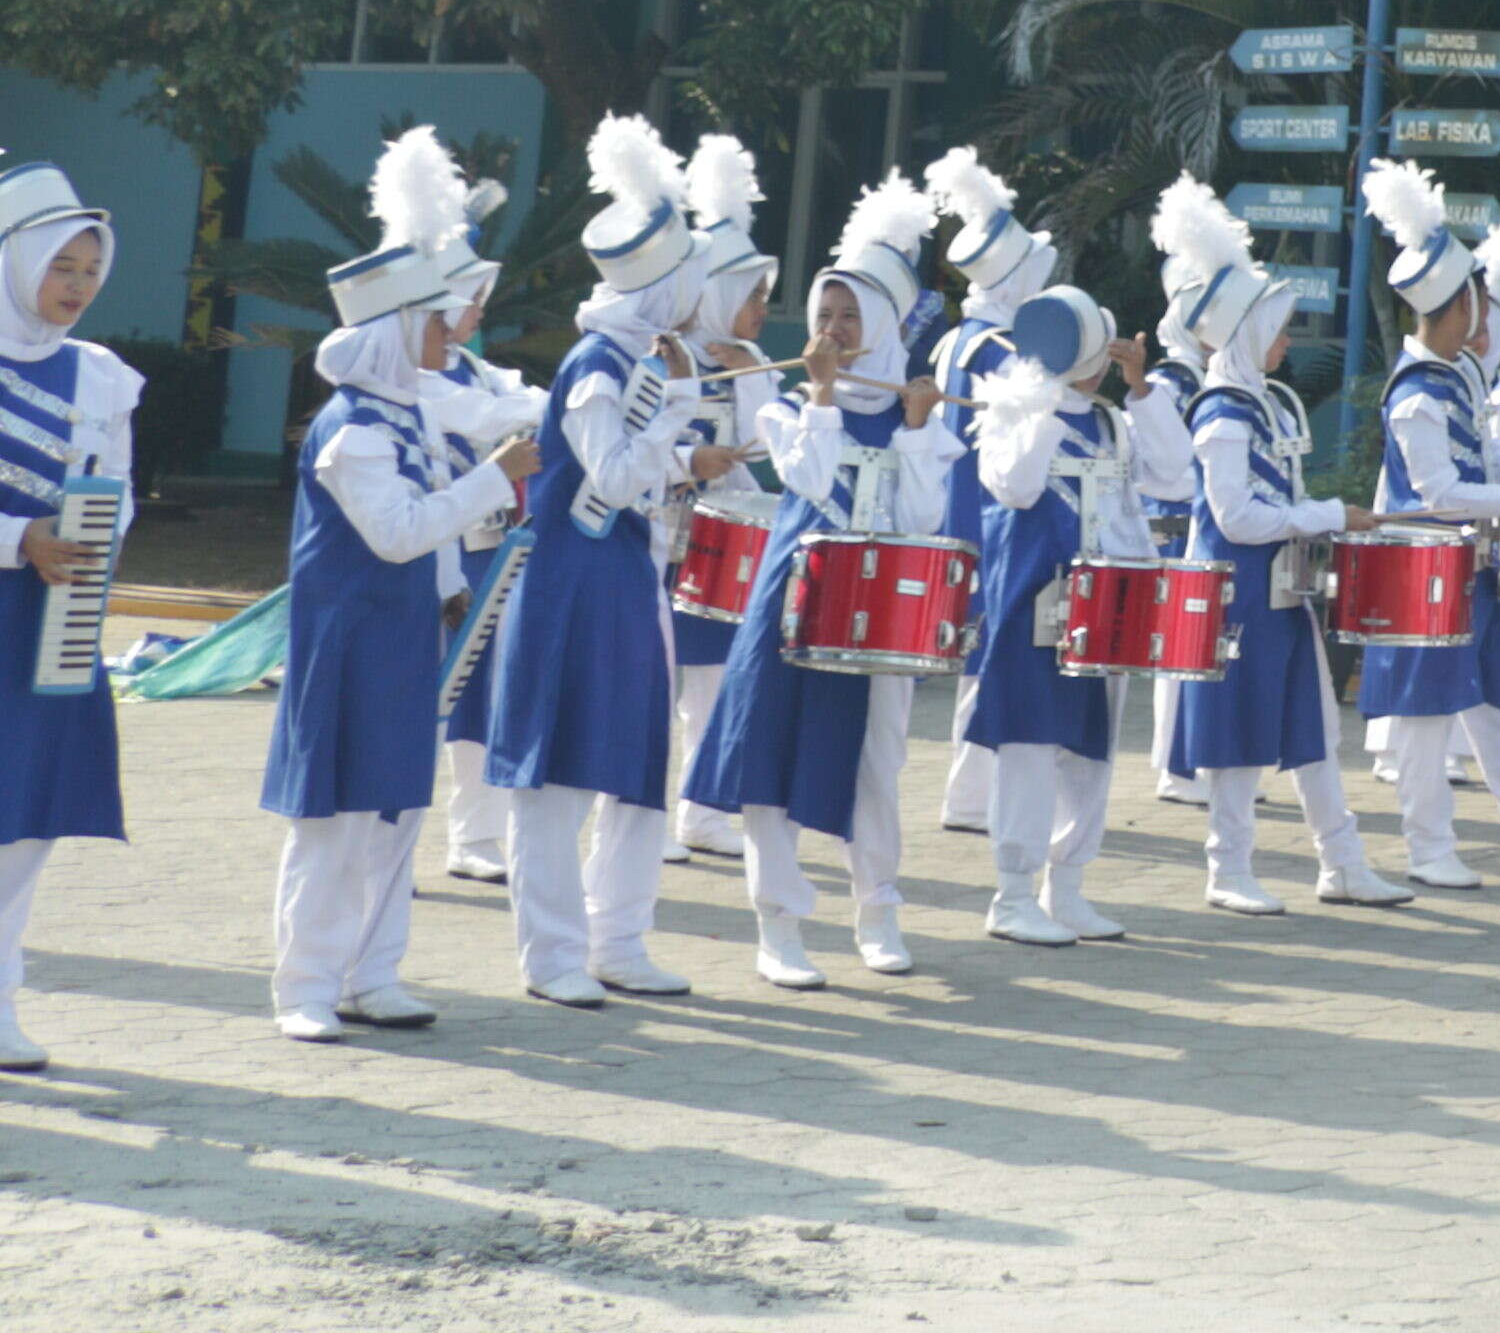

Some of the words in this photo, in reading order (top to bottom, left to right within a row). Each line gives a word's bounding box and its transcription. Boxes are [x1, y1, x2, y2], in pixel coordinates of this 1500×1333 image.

[1252, 52, 1338, 70] SISWA
[1403, 50, 1497, 70] KARYAWAN
[1240, 119, 1283, 139] SPORT
[1285, 119, 1338, 139] CENTER
[1437, 121, 1492, 144] FISIKA
